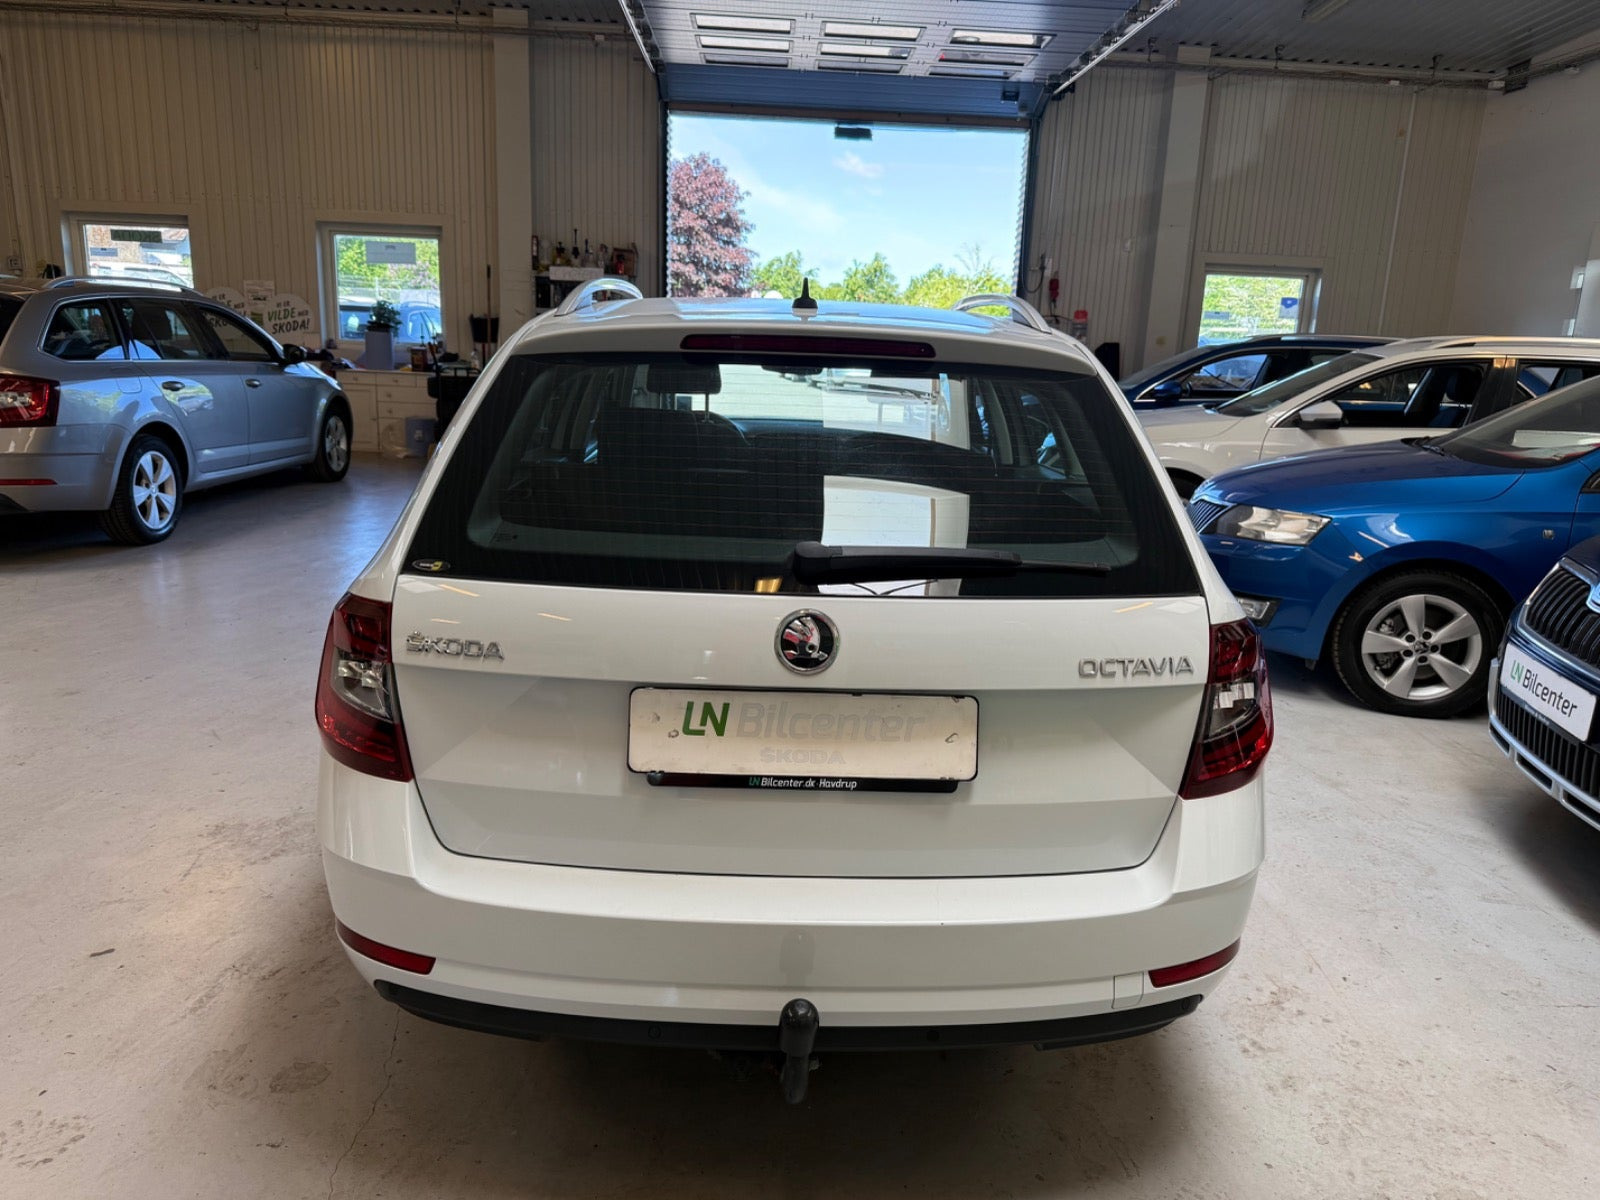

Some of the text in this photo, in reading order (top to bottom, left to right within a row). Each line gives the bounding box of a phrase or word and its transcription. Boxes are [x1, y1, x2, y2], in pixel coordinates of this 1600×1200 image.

[267, 307, 296, 322] VILDE
[271, 318, 310, 335] SKODA!
[405, 631, 504, 660] ŠKODA
[1078, 656, 1194, 679] OCTAVIA
[1511, 660, 1524, 683] LN
[1522, 668, 1578, 718] Bilcenter
[682, 700, 926, 743] LN Bilcenter
[758, 746, 847, 765] ŠKODA
[748, 776, 760, 787] LN
[818, 778, 858, 790] Havdrup
